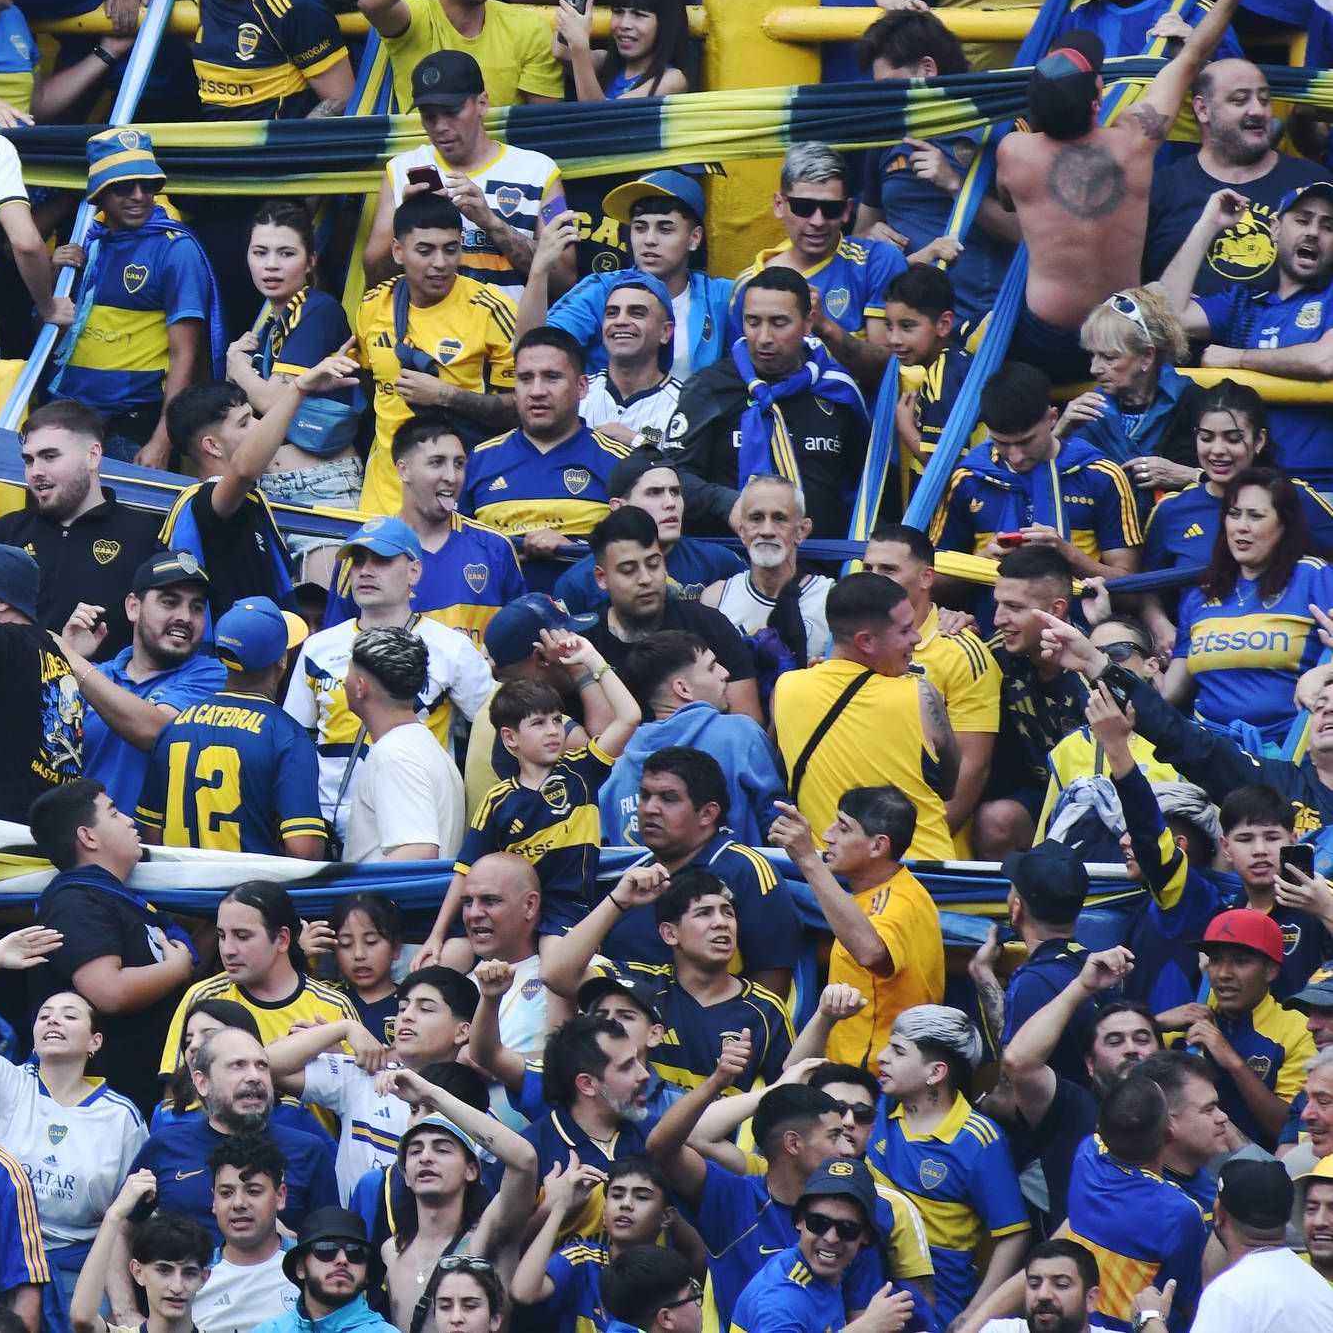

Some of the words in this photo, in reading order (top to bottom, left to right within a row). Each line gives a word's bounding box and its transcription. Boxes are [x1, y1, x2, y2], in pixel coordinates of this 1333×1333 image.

[296, 41, 330, 63] TROGAR
[199, 74, 254, 96] tsson
[125, 273, 145, 281] CABJ
[83, 325, 134, 346] sson
[566, 475, 587, 484] CABJ
[94, 546, 116, 555] CABJ
[1190, 629, 1290, 655] etsson
[175, 704, 193, 726] LA
[195, 703, 266, 735] CATEDRAL
[164, 740, 243, 853] 12
[545, 789, 564, 801] CABJ
